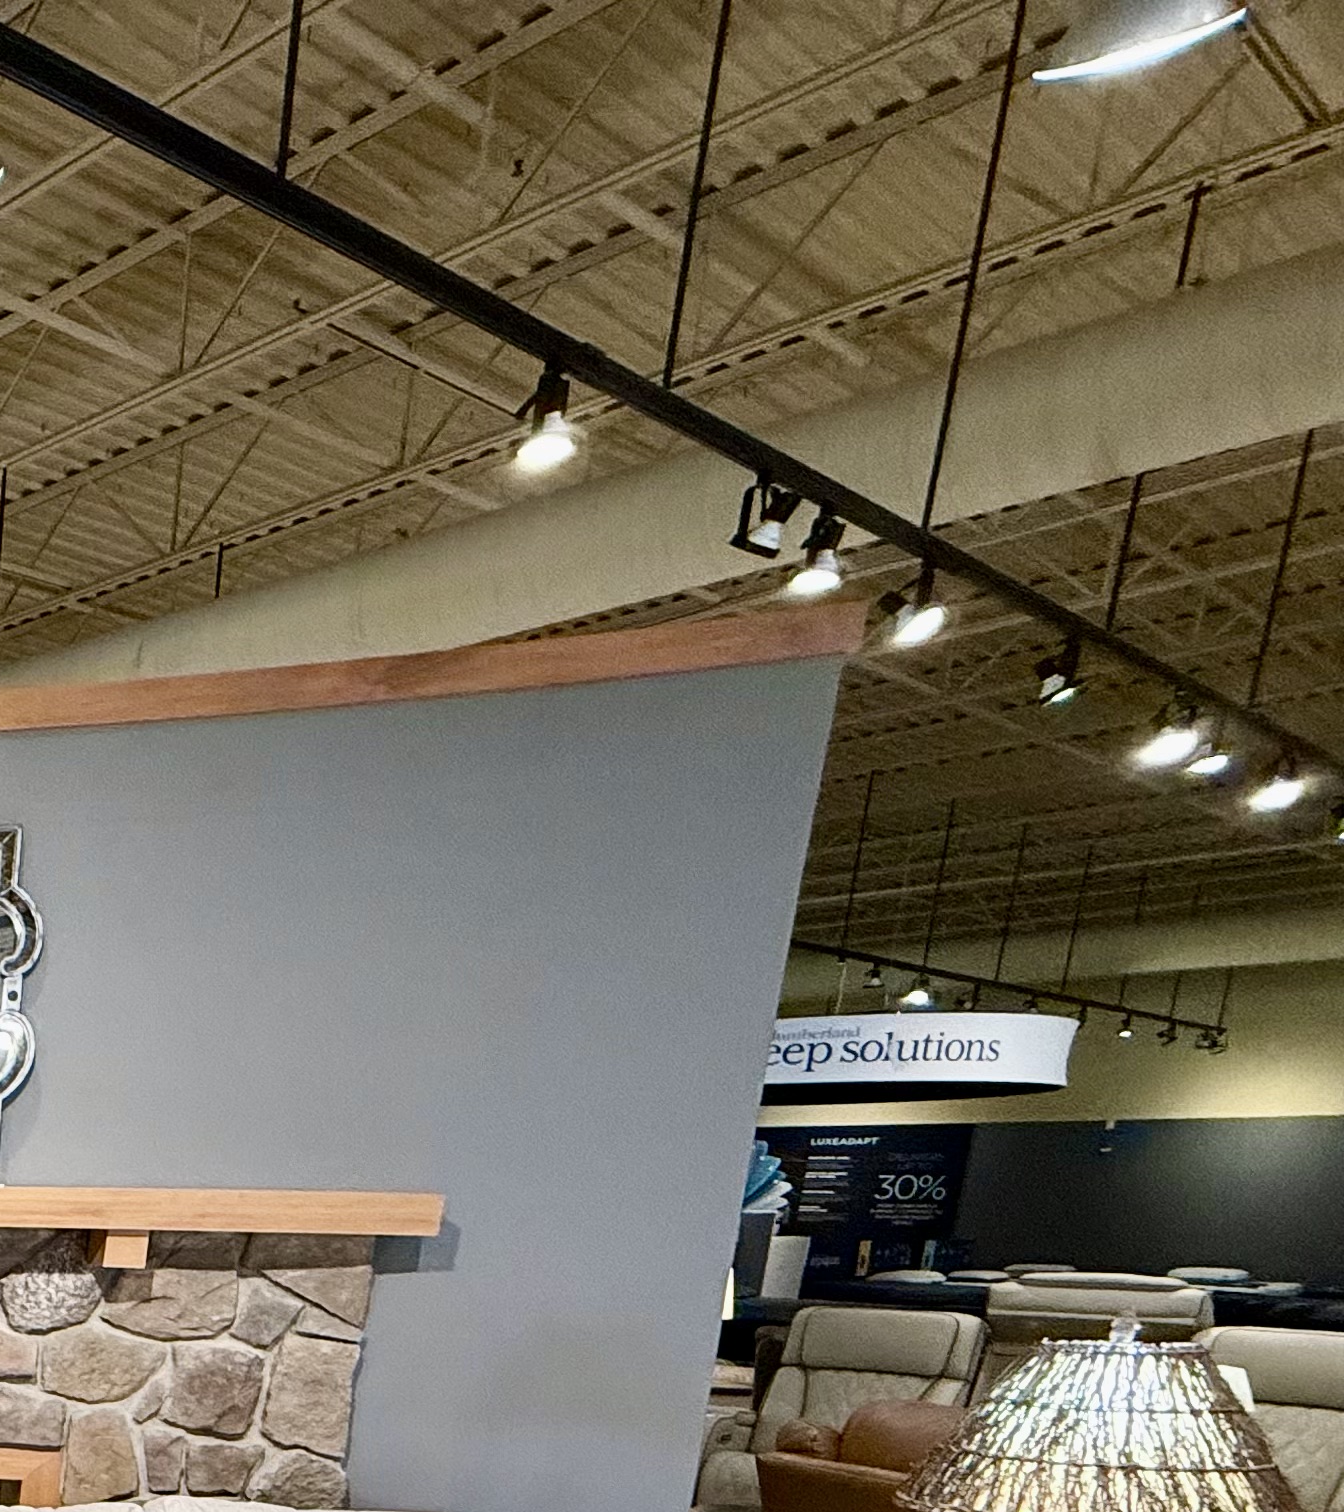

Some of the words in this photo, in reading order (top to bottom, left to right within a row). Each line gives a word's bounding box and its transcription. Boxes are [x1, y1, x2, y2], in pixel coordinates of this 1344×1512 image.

[839, 1032, 1001, 1063] solutions
[810, 1136, 881, 1147] LUXEADAPT
[873, 1174, 947, 1201] 30%
